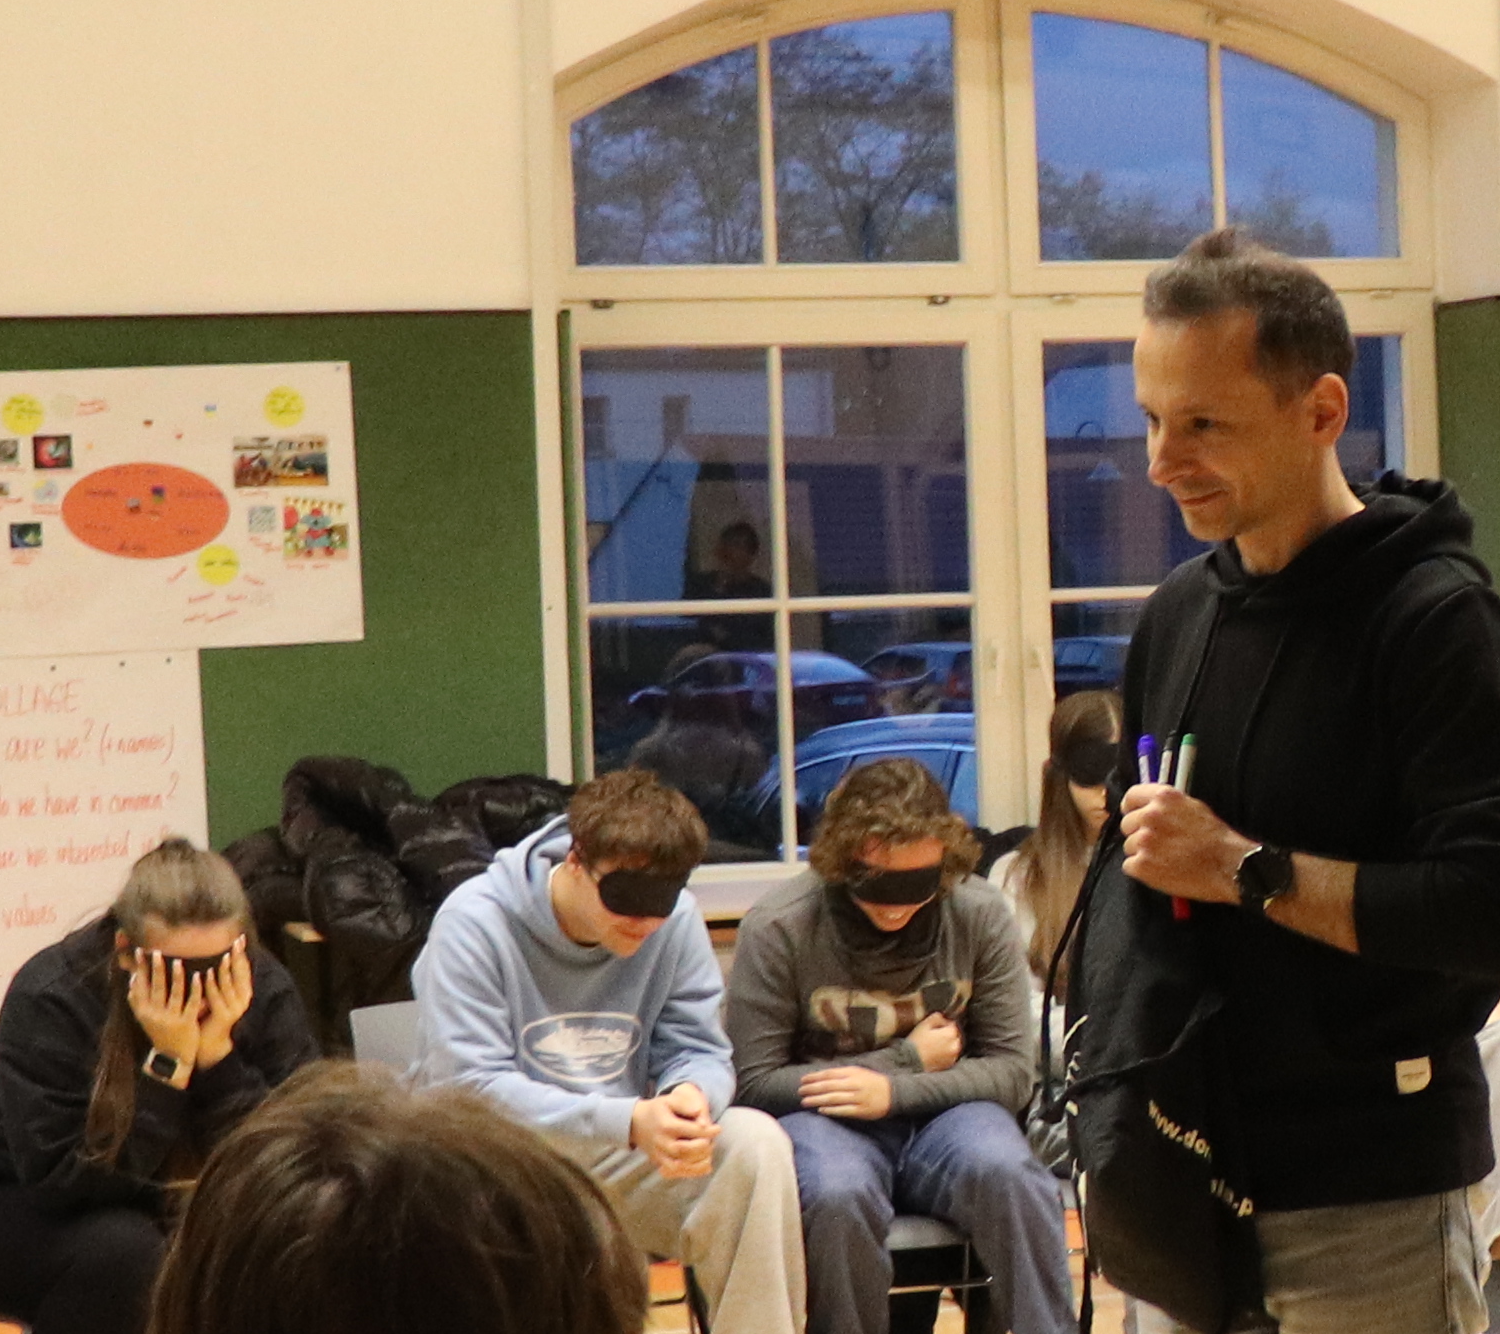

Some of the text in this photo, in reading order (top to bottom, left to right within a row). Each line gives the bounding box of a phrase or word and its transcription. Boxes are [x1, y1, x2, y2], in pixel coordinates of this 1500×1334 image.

[5, 736, 45, 761] are
[18, 795, 37, 816] we
[43, 783, 80, 815] have
[26, 847, 48, 867] we
[1, 892, 57, 929] values
